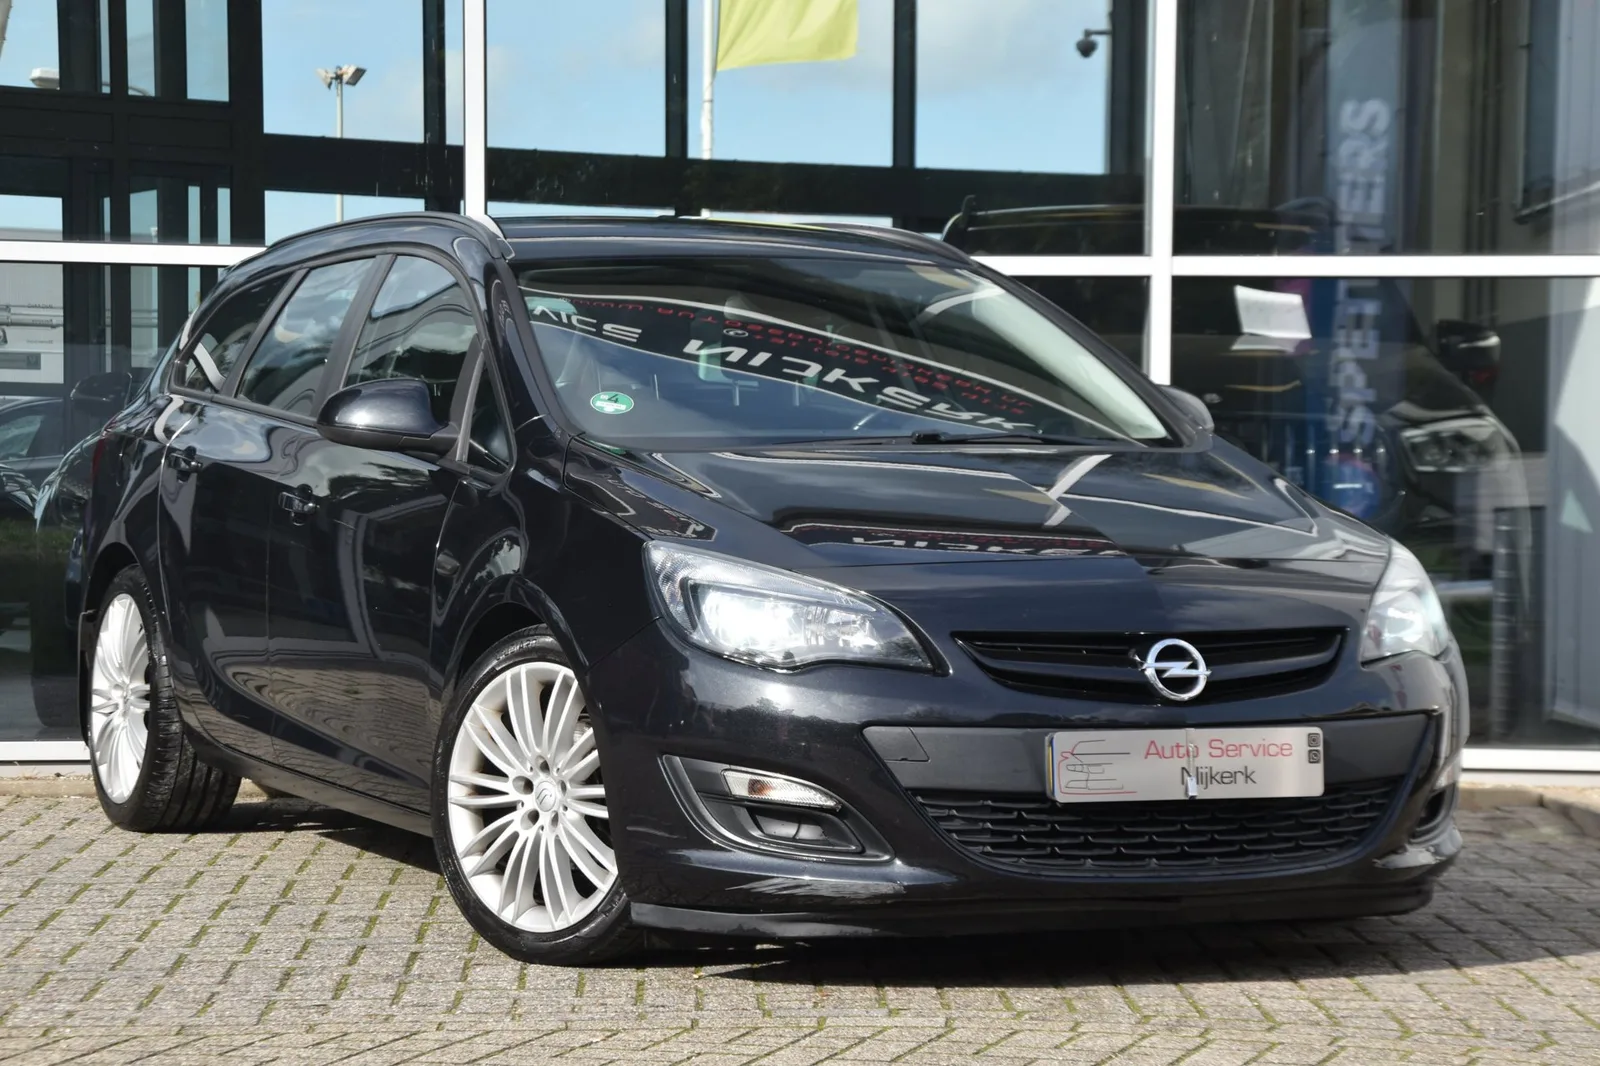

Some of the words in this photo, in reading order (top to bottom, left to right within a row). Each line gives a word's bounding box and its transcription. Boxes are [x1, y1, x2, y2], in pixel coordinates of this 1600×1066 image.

[1144, 739, 1200, 760] Auto
[1208, 738, 1294, 758] Service
[1180, 766, 1257, 790] Nijkerk
